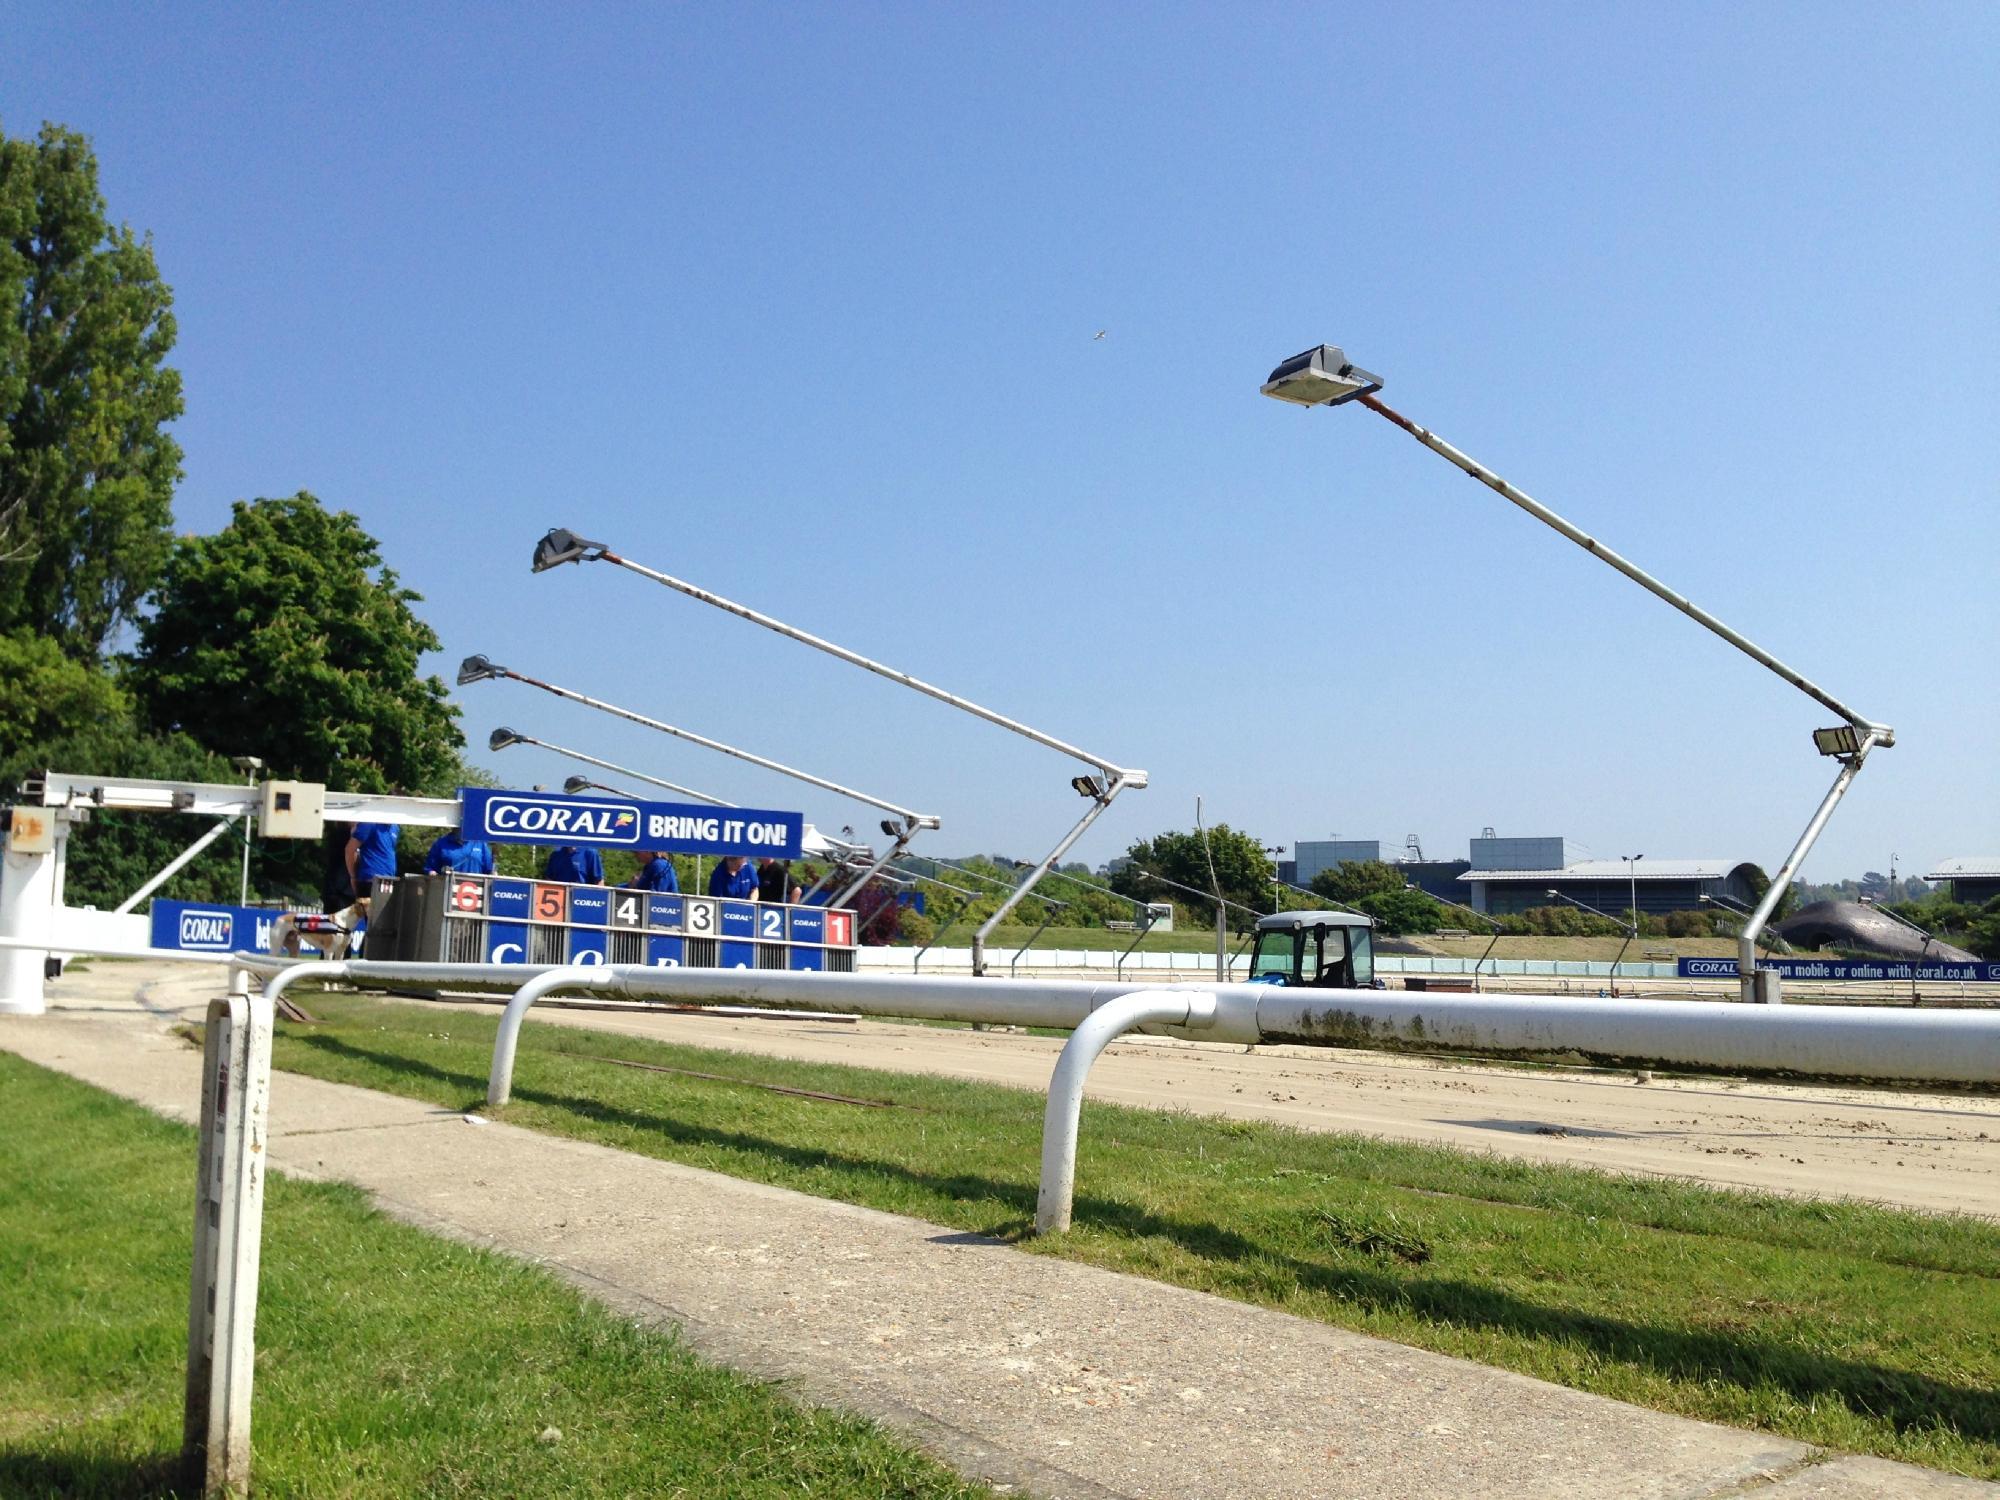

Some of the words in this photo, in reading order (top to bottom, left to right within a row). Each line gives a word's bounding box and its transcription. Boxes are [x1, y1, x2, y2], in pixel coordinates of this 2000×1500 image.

[494, 805, 615, 834] CORAL
[650, 815, 719, 841] BRING
[724, 820, 745, 842] IT
[747, 822, 787, 846] ON!
[456, 881, 479, 911] 6
[494, 891, 523, 900] CORAL
[539, 889, 560, 917] 5
[574, 899, 602, 907] CORAL
[617, 897, 639, 925] 4
[651, 906, 677, 915] CORAL
[692, 904, 711, 930] 3
[724, 912, 749, 921] CORAL
[793, 919, 818, 927] CORAL
[182, 918, 224, 942] CORAL
[763, 910, 781, 937] 2
[831, 916, 844, 942] 1
[1690, 963, 1736, 973] CORAL
[1779, 965, 1792, 976] on
[1795, 963, 1830, 977] mobile
[1834, 966, 1846, 977] or
[1851, 964, 1883, 978] online
[1888, 964, 1912, 978] with
[1915, 965, 1977, 979] coral.co.uk
